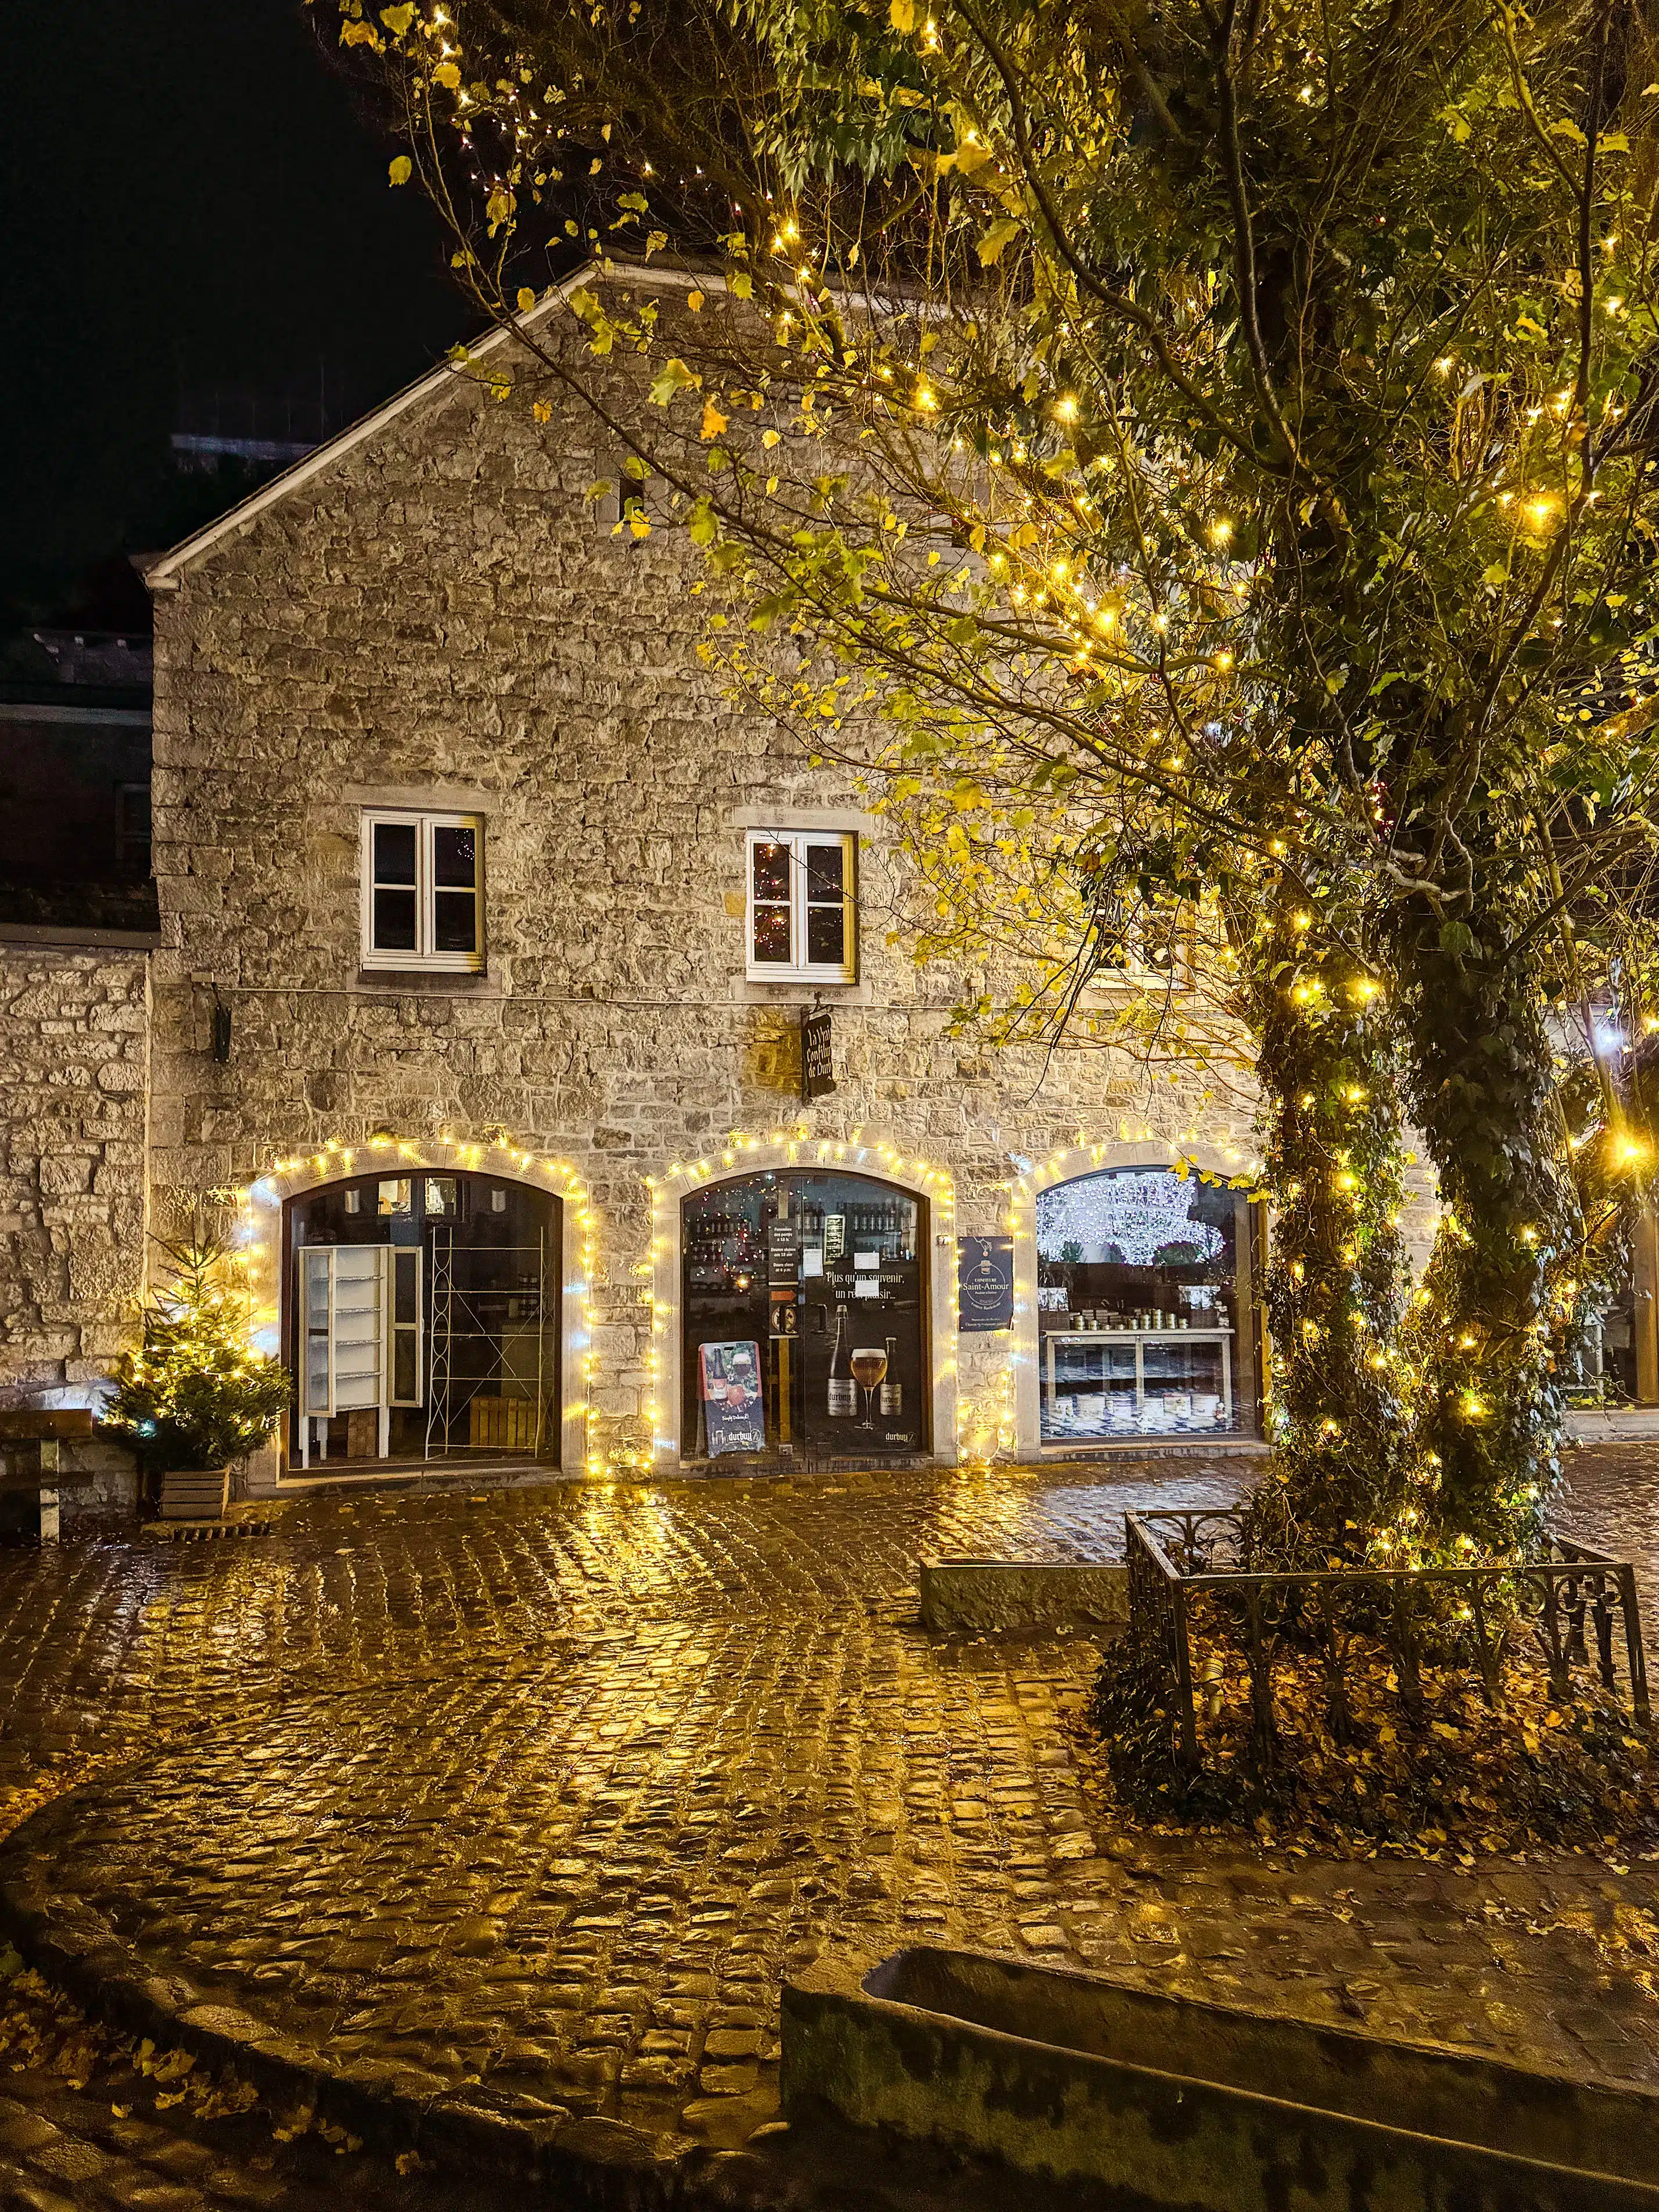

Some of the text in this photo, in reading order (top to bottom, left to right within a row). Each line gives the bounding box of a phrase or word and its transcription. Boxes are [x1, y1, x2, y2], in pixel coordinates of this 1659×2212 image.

[809, 1062, 816, 1078] de
[825, 1271, 843, 1285] Plus
[835, 1290, 845, 1299] un
